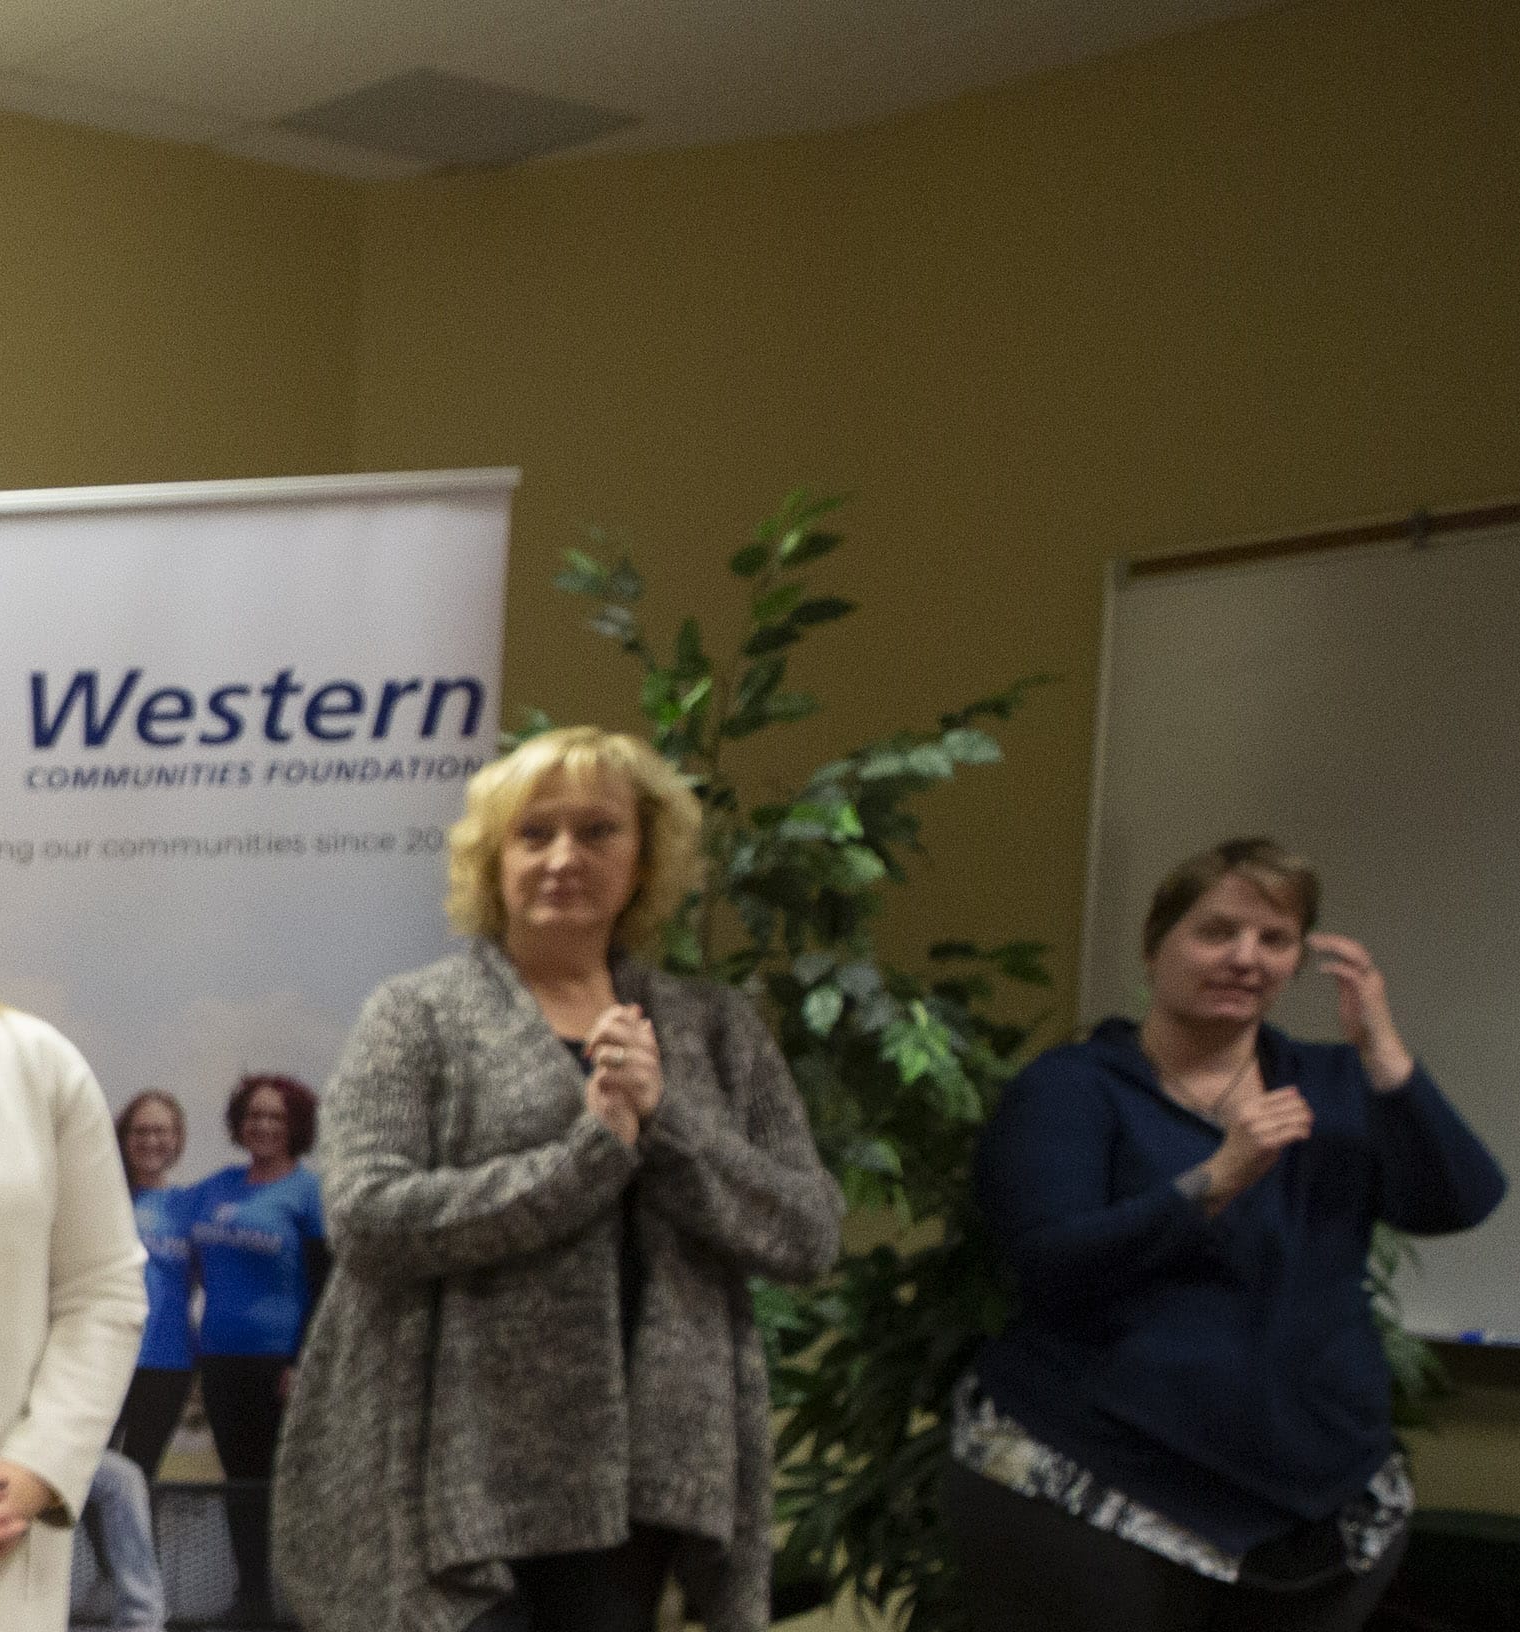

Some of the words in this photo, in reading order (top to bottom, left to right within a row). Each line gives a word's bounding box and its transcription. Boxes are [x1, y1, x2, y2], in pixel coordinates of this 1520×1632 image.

[27, 667, 487, 750] Western
[25, 763, 253, 791] COMMUNITIES
[265, 754, 484, 785] FOUNDATION
[43, 837, 91, 860] our
[100, 832, 305, 859] communities
[315, 830, 397, 854] since
